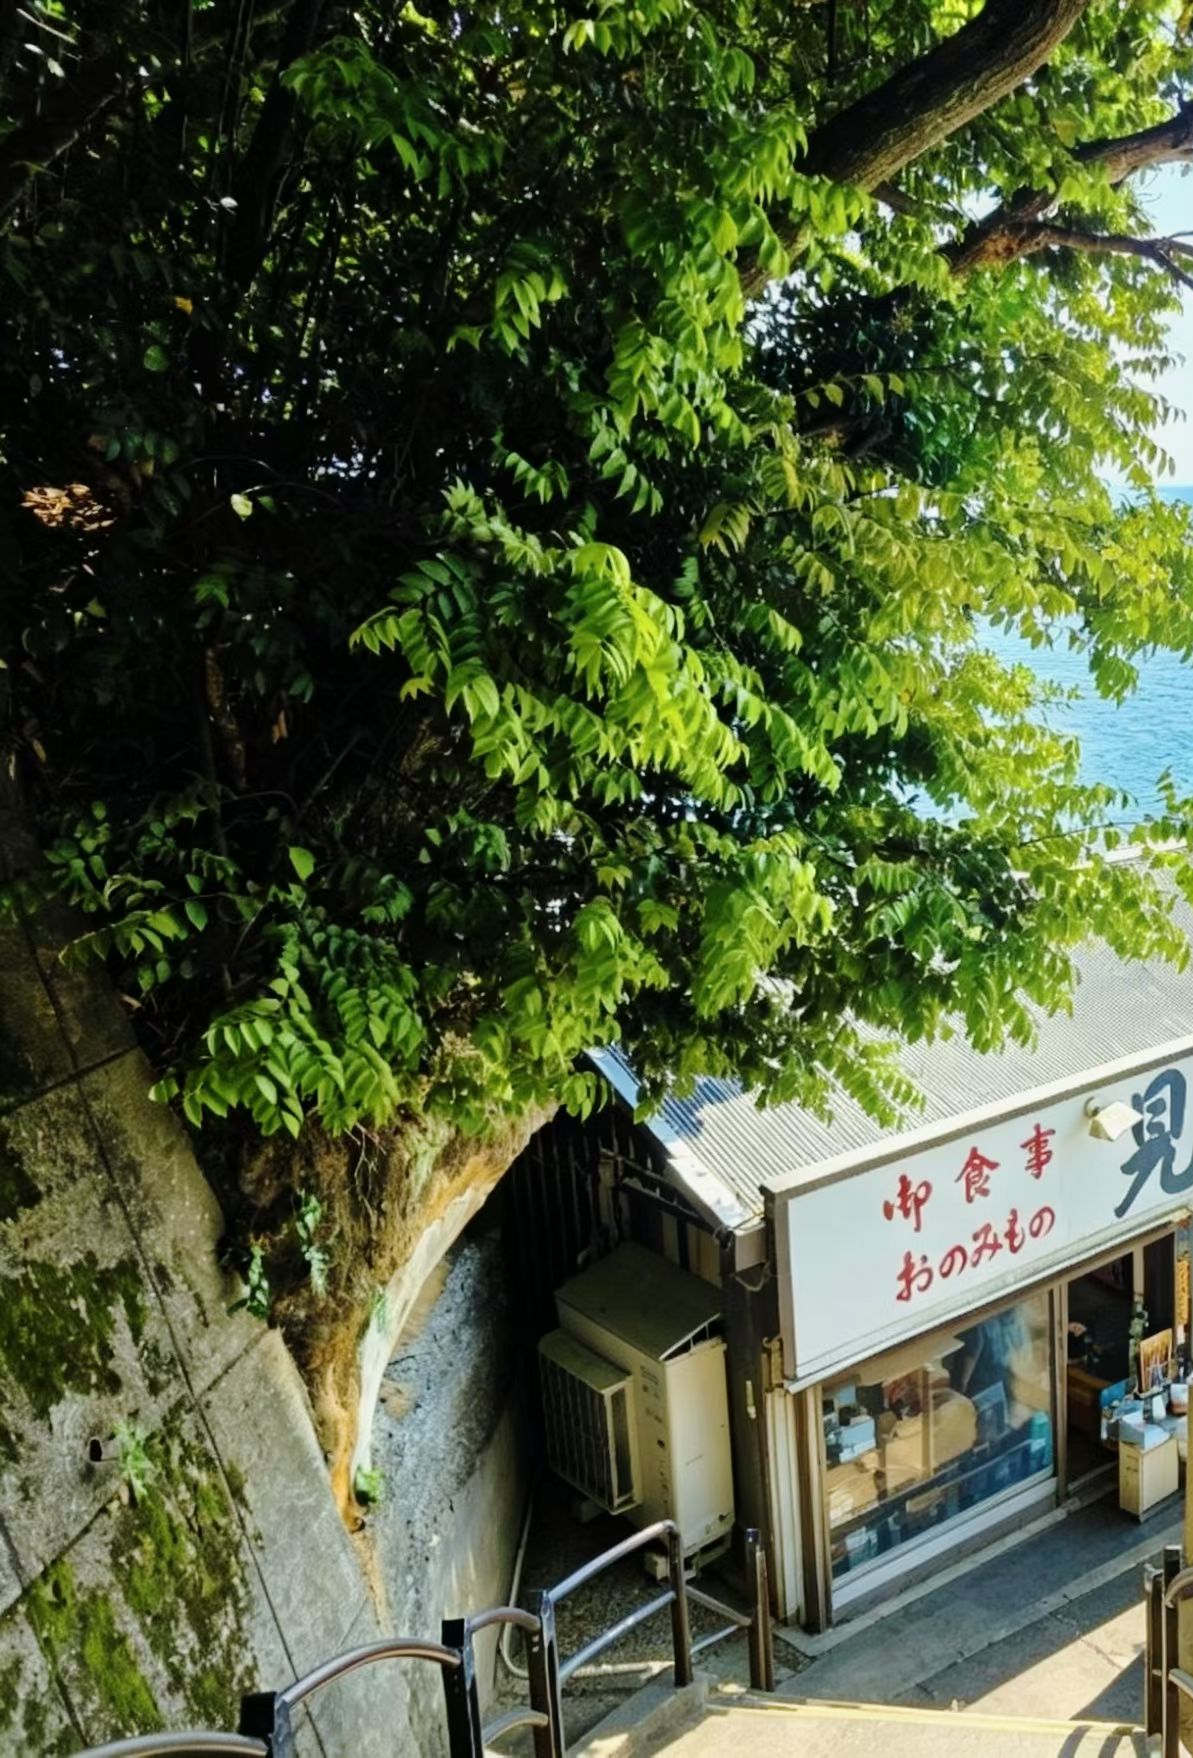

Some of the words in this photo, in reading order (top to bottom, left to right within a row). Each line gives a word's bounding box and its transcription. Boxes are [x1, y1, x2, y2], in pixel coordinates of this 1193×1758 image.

[882, 1123, 1056, 1233] 御食事
[896, 1206, 1056, 1302] おのみもの
